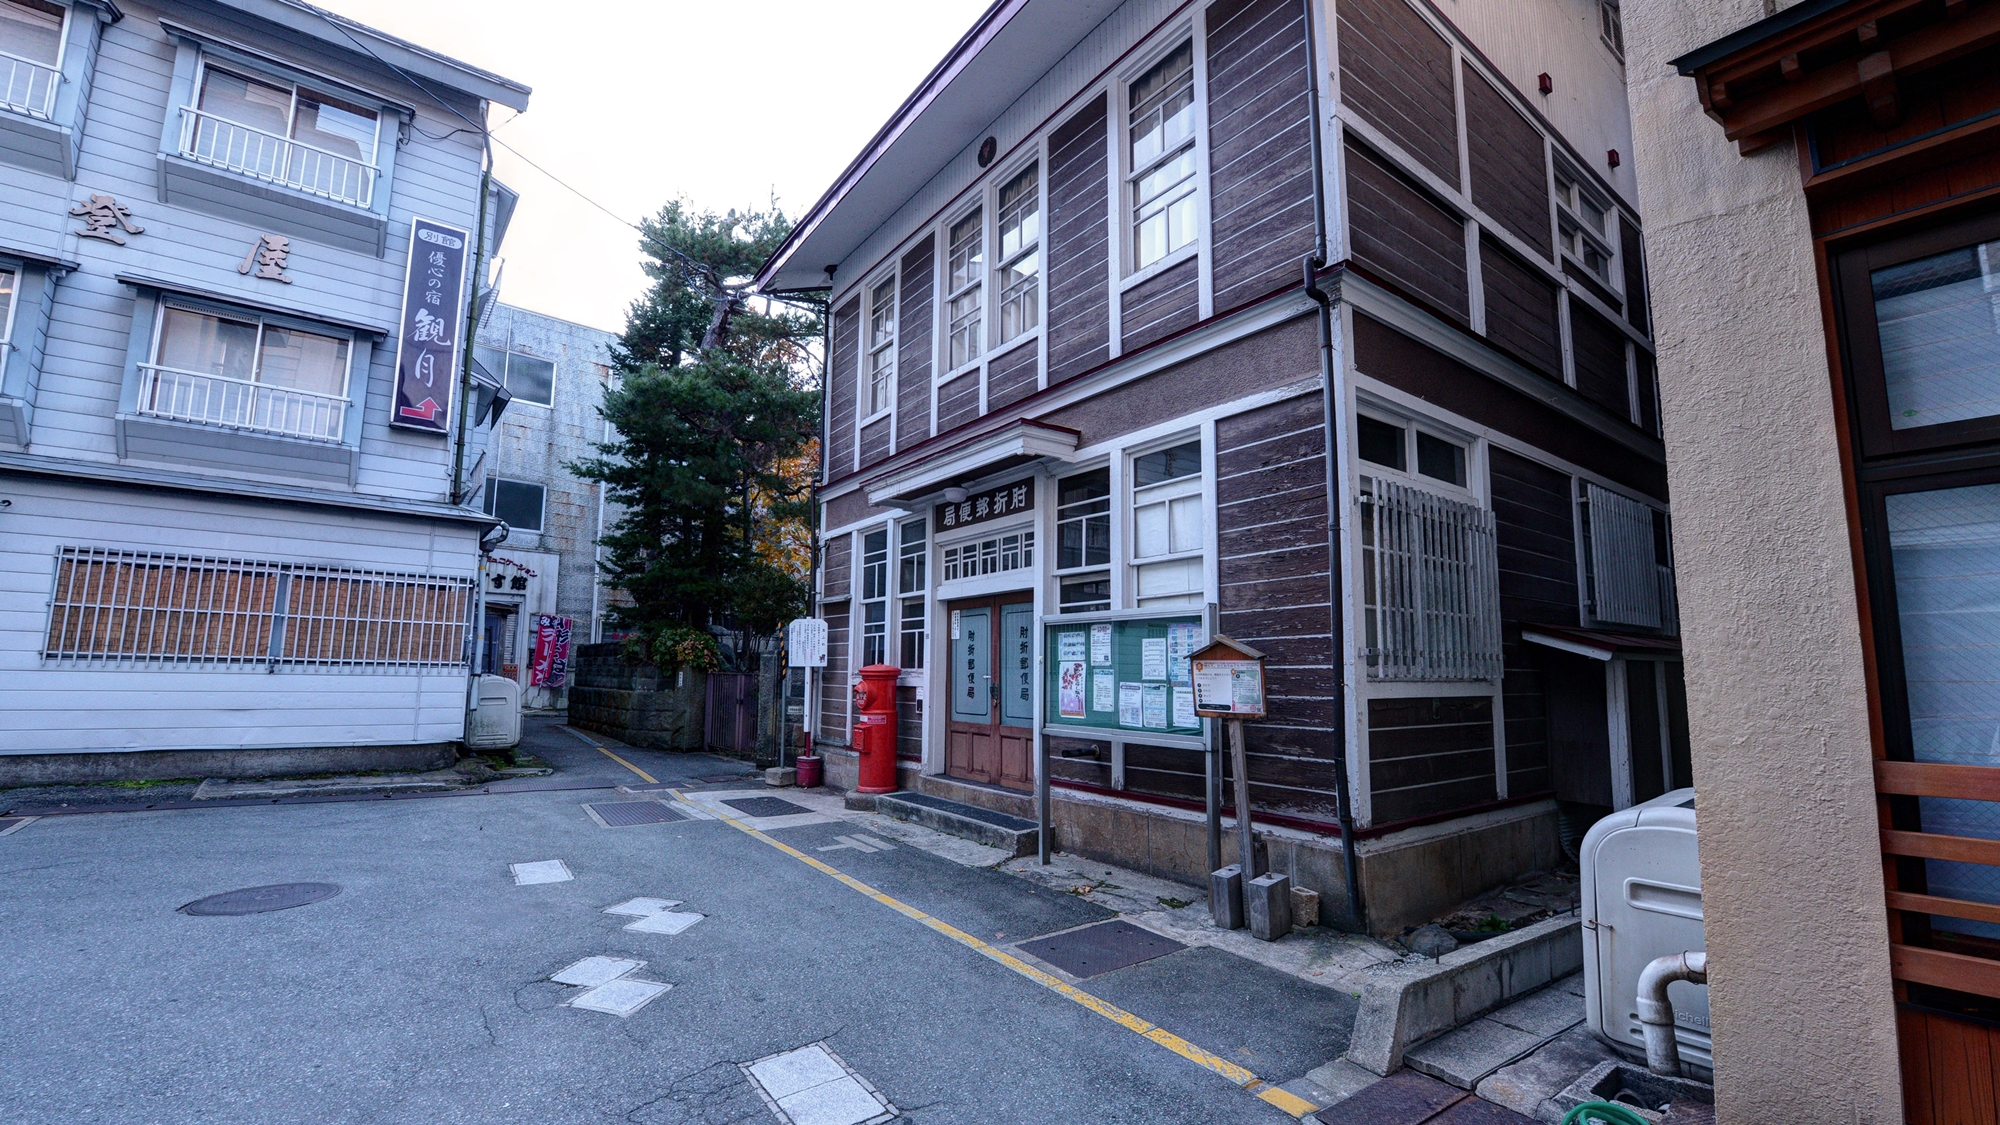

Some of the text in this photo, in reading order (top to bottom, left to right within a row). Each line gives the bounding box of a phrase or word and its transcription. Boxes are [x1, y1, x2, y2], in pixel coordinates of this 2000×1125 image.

[424, 231, 457, 247] 別館
[426, 250, 447, 306] 優心の宿
[407, 307, 451, 388] 観月
[1674, 1009, 1709, 1027] ichell
